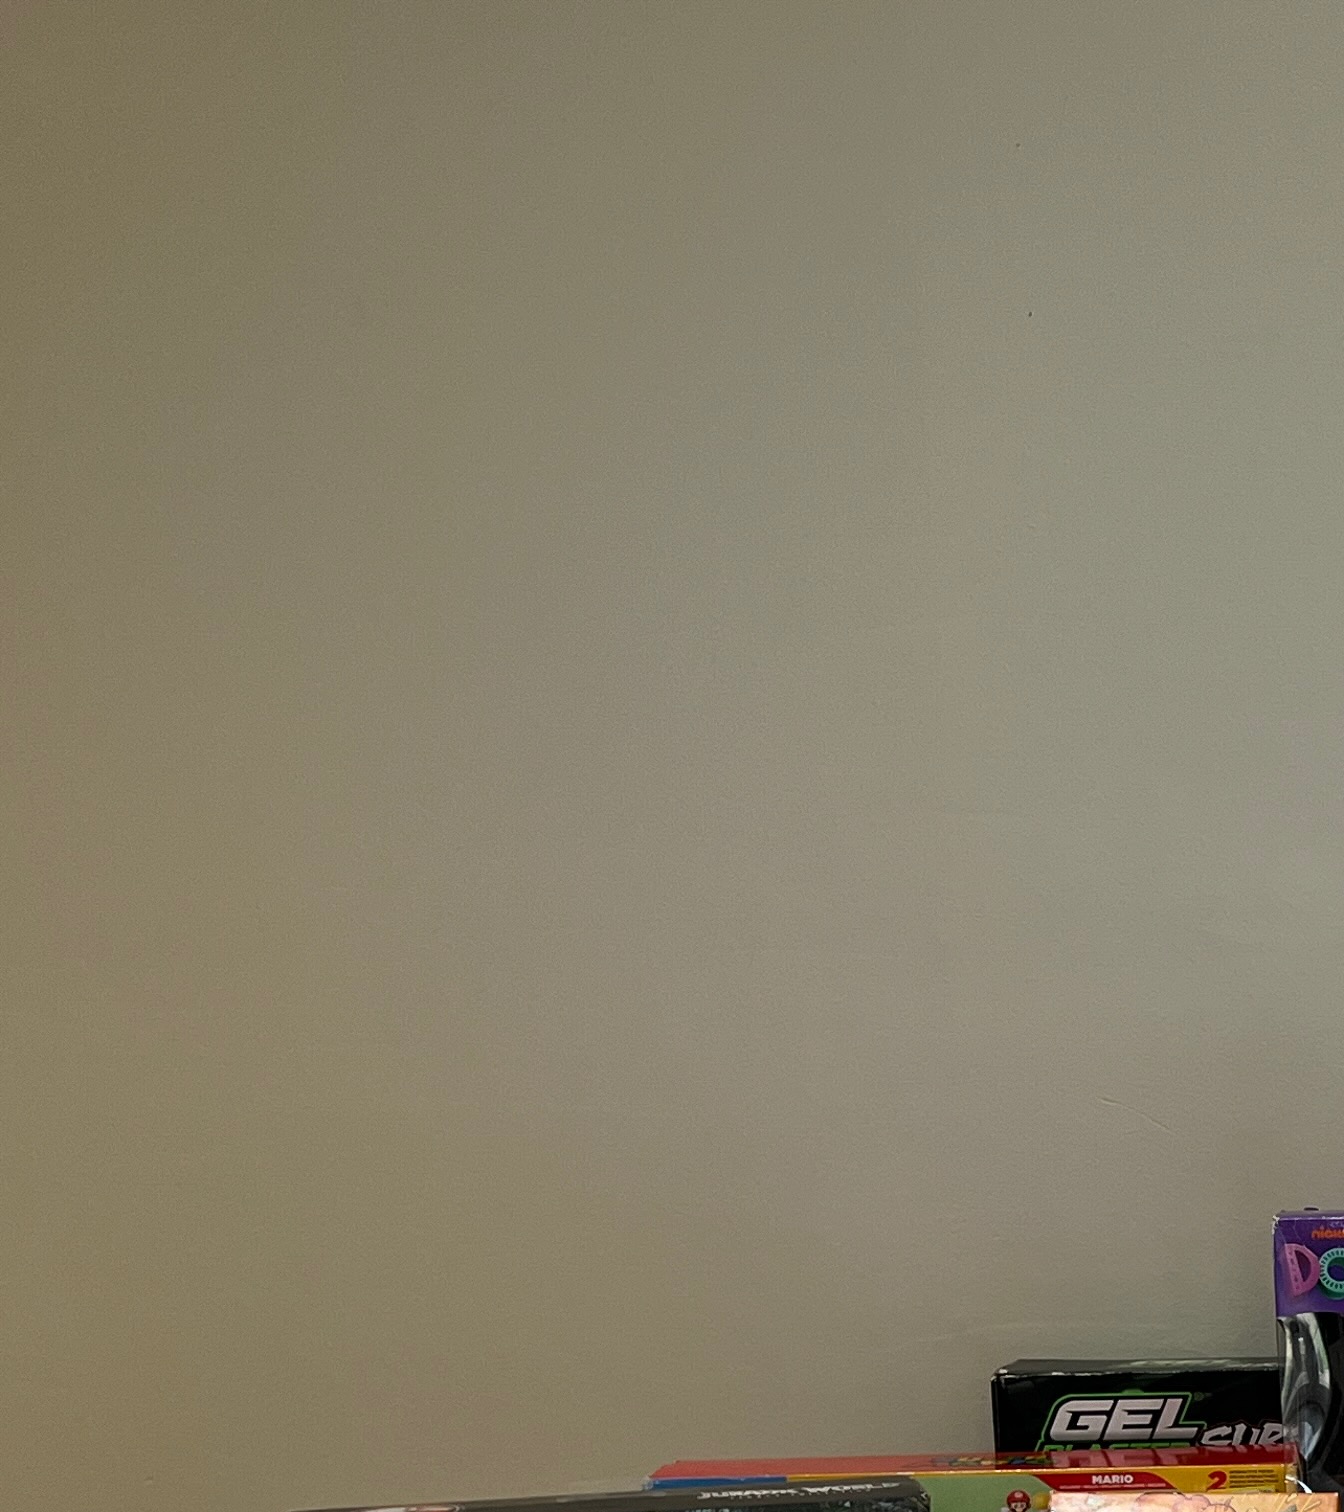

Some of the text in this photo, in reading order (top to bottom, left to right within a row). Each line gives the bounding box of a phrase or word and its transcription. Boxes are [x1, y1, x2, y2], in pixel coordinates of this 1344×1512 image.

[1050, 1398, 1198, 1442] GEL
[1092, 1474, 1134, 1485] MARIO
[1206, 1471, 1227, 1492] 2
